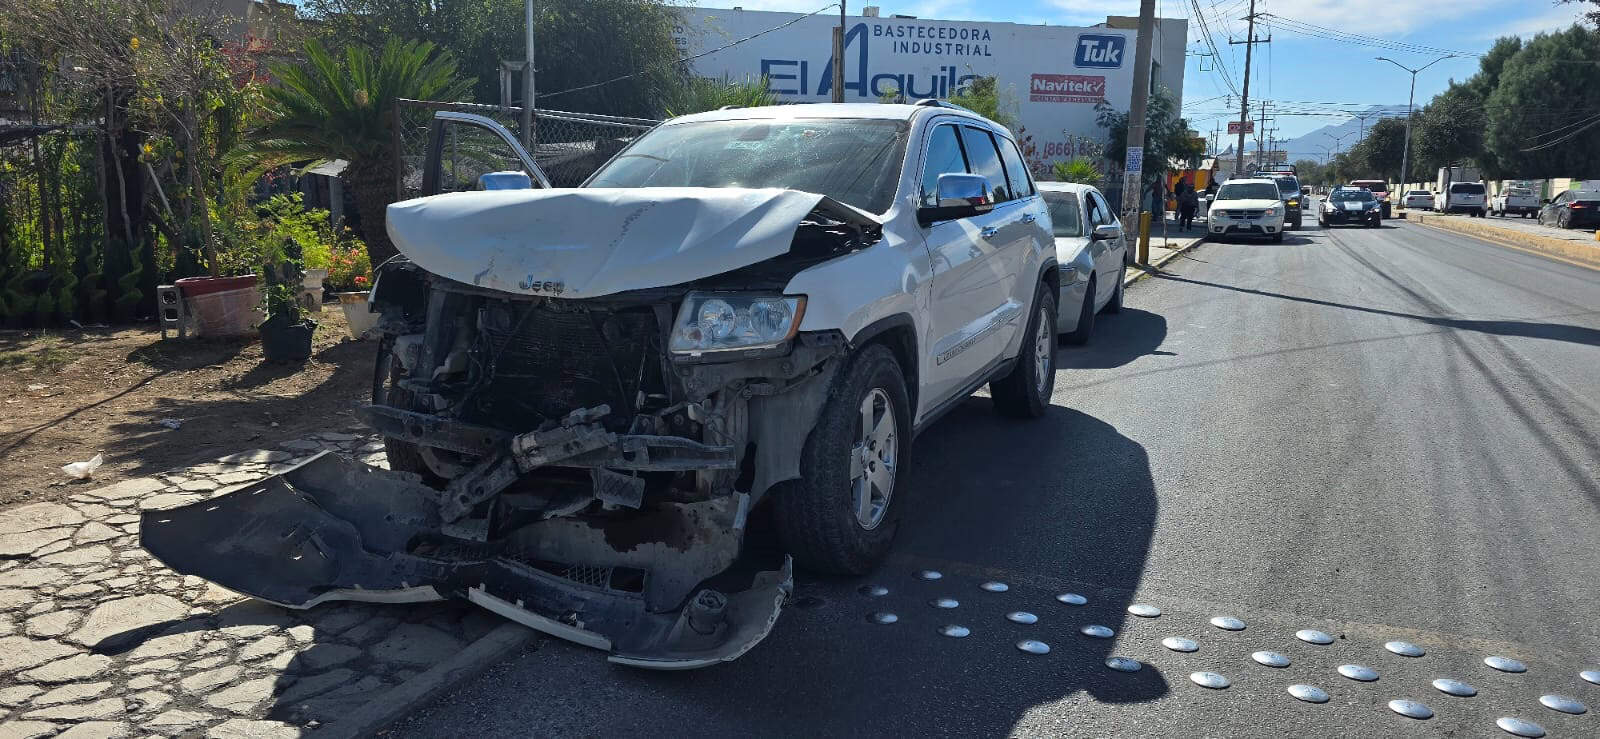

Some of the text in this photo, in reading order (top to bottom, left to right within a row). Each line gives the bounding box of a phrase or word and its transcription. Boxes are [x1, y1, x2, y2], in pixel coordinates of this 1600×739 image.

[893, 41, 992, 57] INDUSTRIAL
[1081, 40, 1120, 63] Tuk
[761, 59, 808, 96] El
[1033, 79, 1093, 92] Navitek
[519, 272, 565, 294] Jeep
